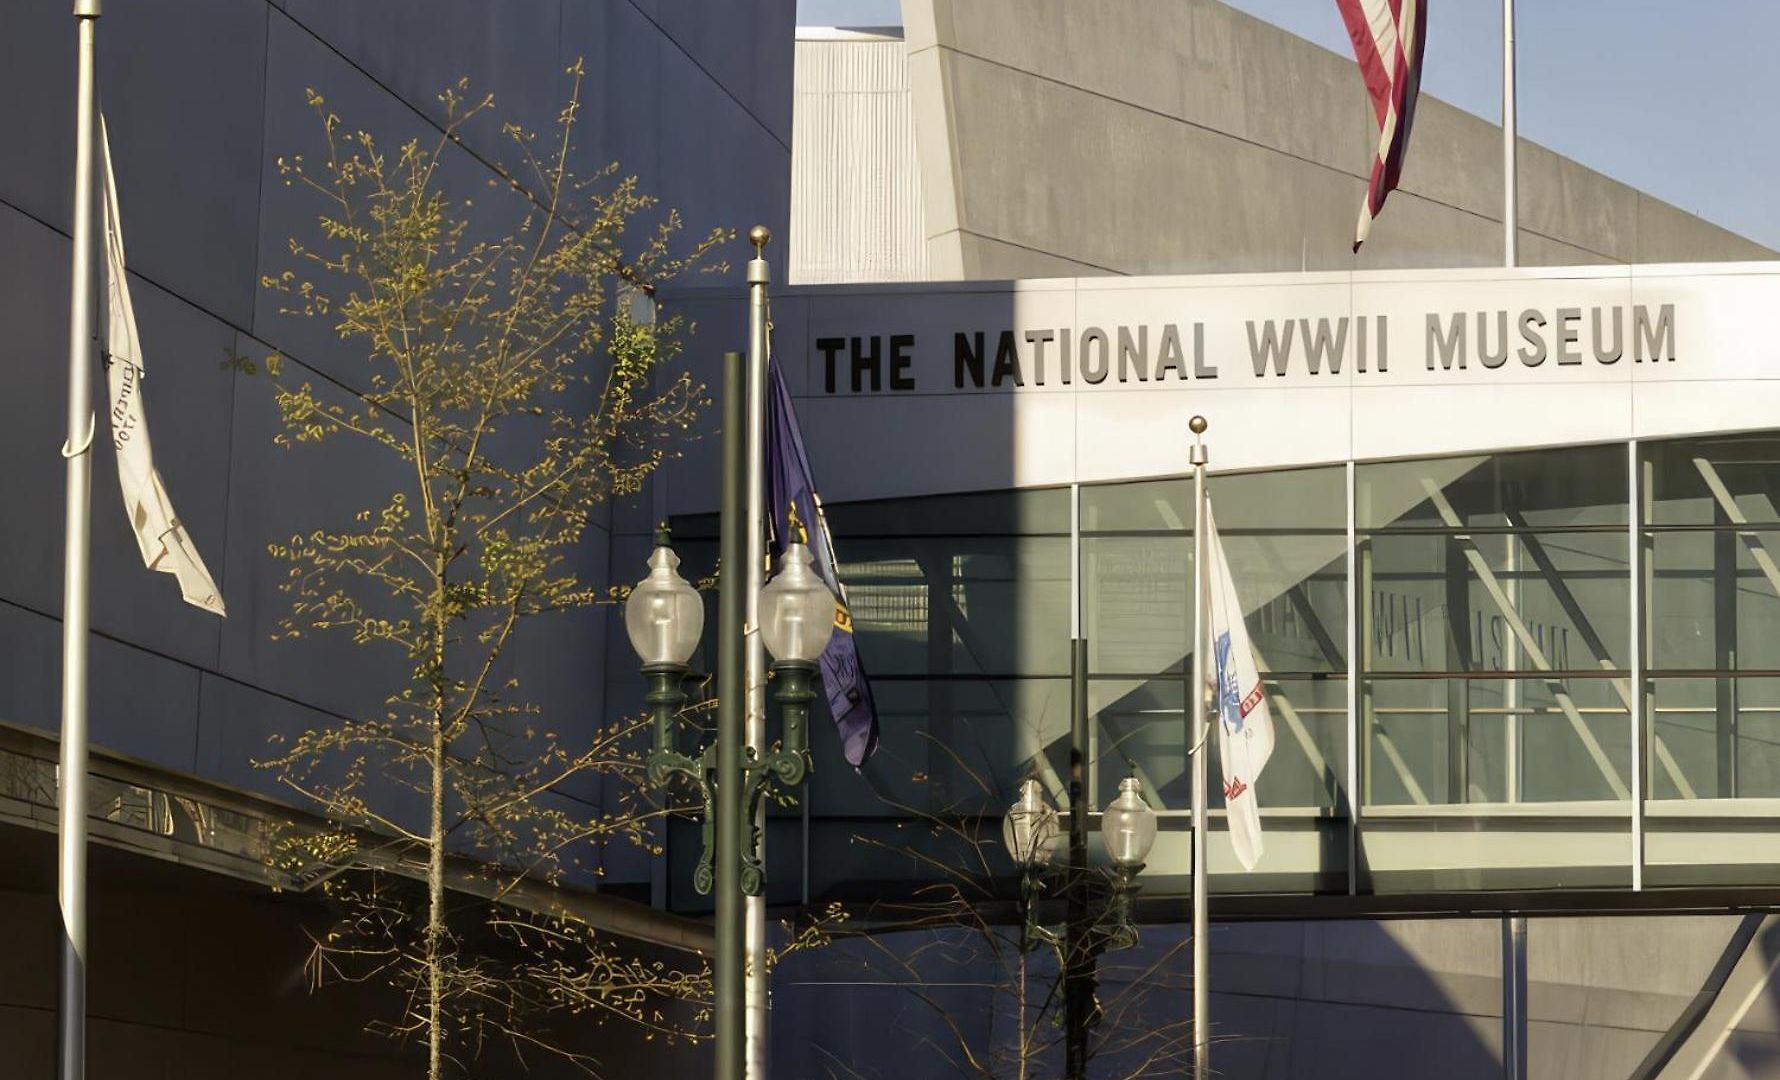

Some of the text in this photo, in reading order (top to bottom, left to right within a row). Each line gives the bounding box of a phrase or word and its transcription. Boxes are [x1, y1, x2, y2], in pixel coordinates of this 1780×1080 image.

[816, 303, 1676, 394] THE NATIONAL WWII MUSEUM
